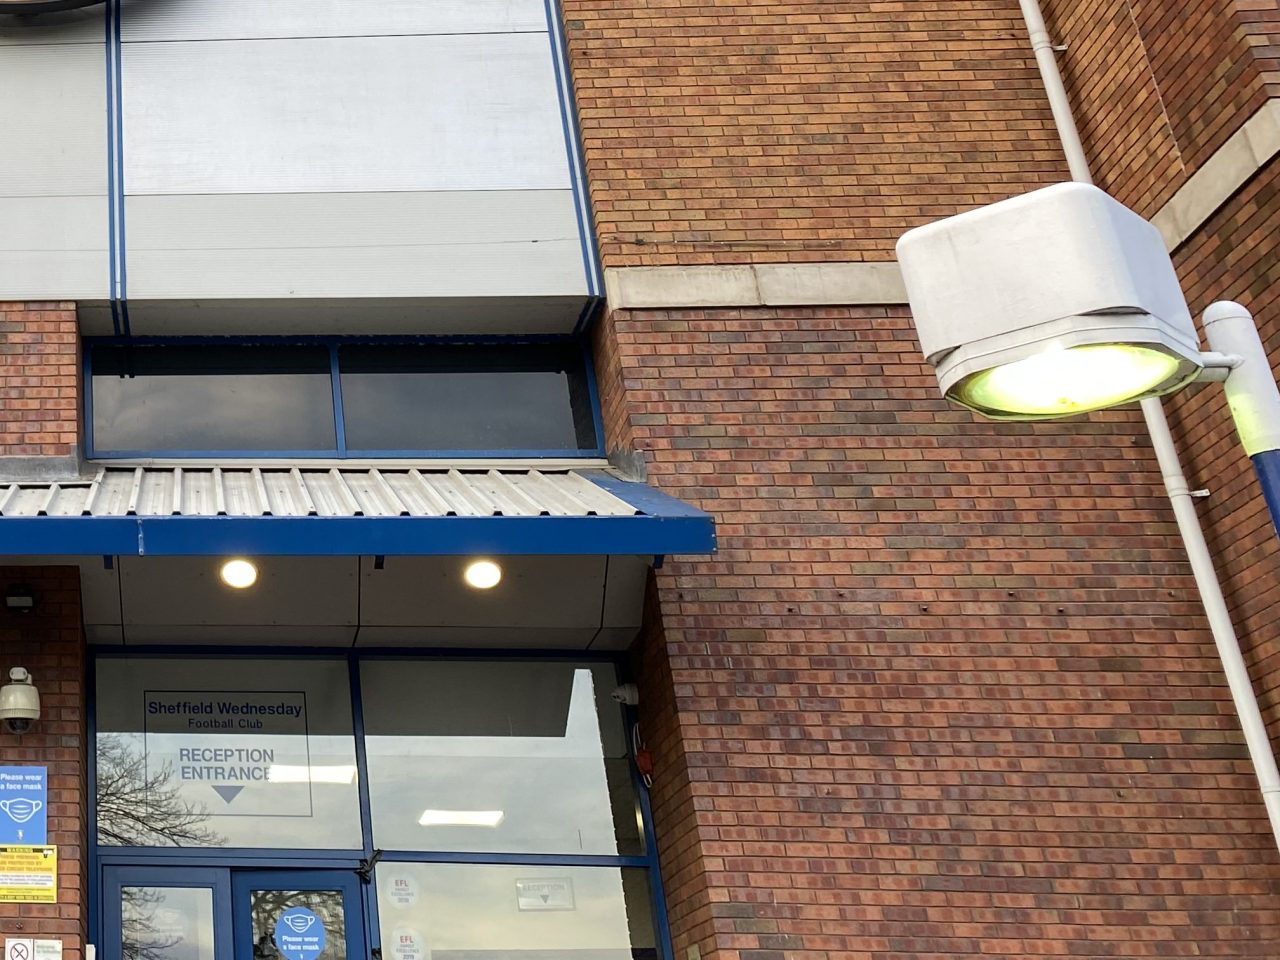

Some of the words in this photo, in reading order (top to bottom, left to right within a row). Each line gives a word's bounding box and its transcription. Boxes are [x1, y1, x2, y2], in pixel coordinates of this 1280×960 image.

[148, 701, 213, 714] Sheffield
[217, 701, 303, 718] Wednesday
[188, 718, 234, 729] Football
[238, 718, 263, 729] Club
[179, 748, 274, 763] RECEPTION
[0, 773, 24, 781] Please
[6, 782, 22, 790] face
[22, 782, 42, 790] mask
[399, 935, 414, 944] EFL
